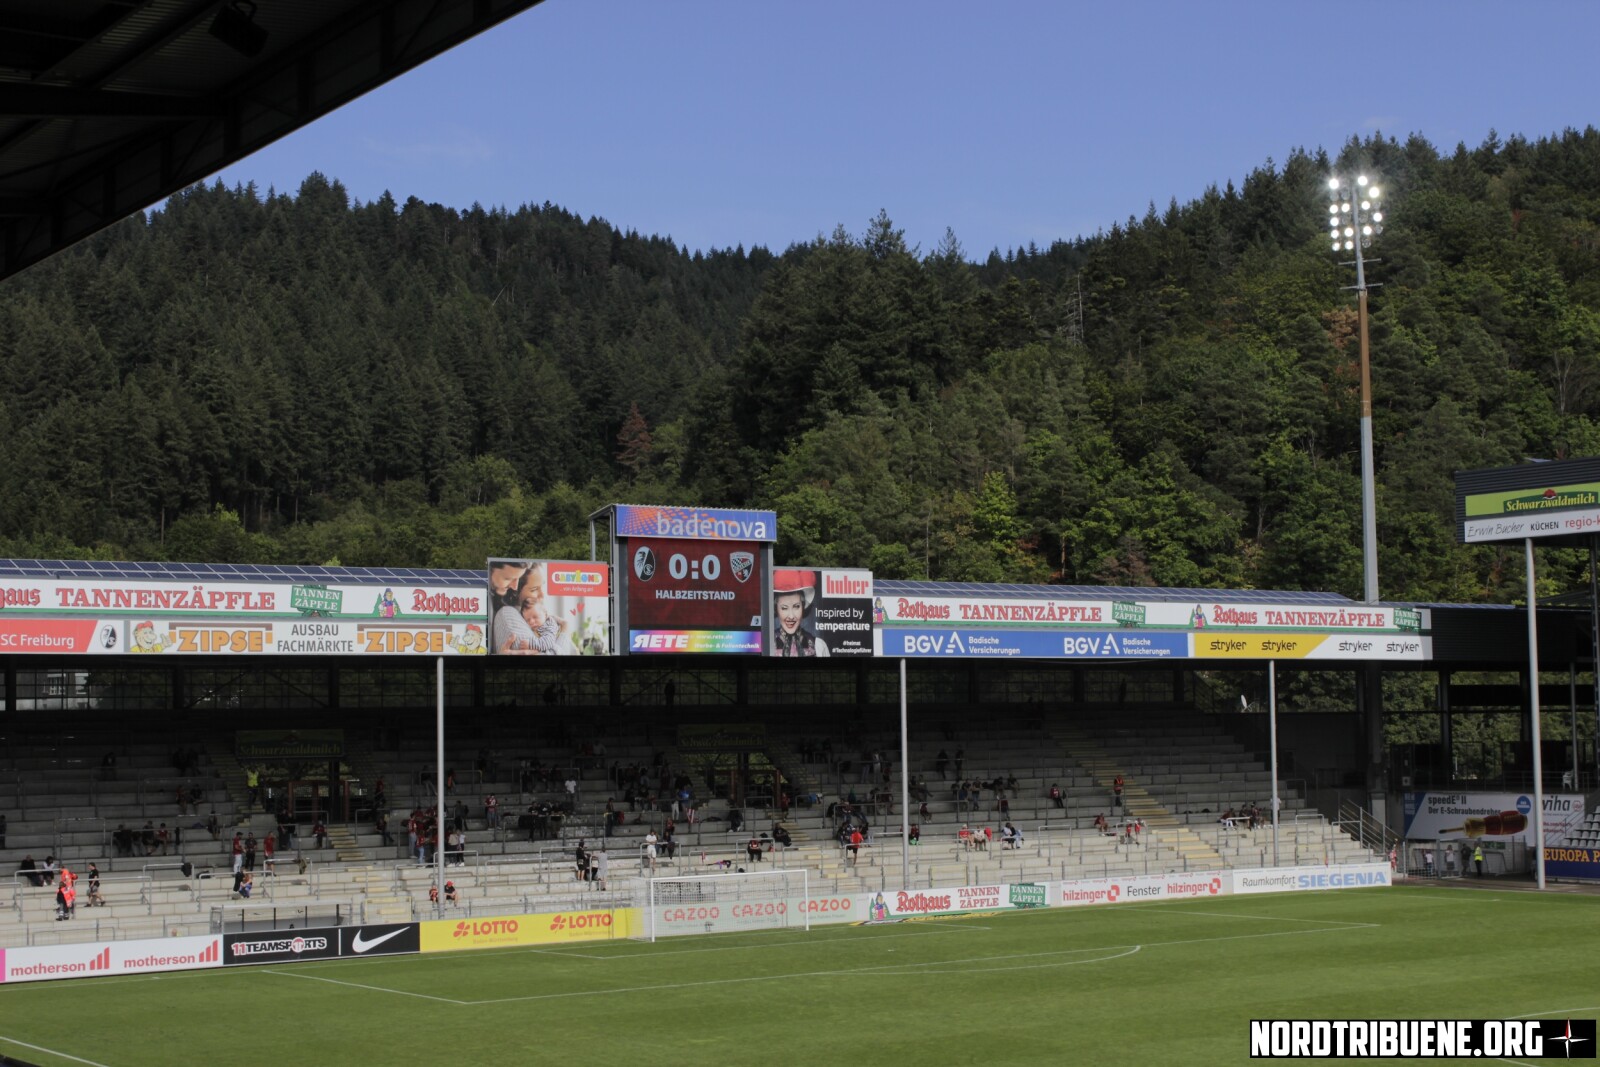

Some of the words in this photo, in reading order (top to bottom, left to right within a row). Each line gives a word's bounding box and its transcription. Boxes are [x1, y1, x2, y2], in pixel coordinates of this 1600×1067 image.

[1506, 493, 1595, 511] Schwarzwaldmilch
[657, 511, 766, 538] badenova
[1467, 525, 1493, 537] Erwin
[1530, 520, 1559, 532] KÜCHEN
[668, 553, 721, 581] 0:0
[554, 570, 600, 583] BABYZONE
[826, 574, 869, 595] huber
[56, 585, 275, 610] TANNENZÄPFLE
[293, 586, 341, 601] TANNEN
[655, 589, 736, 601] HALBZEITSTAND
[294, 597, 338, 612] ZÄPFLE
[411, 588, 480, 616] Rothaus
[1113, 603, 1144, 616] TANNEN
[815, 608, 851, 620] Inspired
[852, 608, 864, 620] by
[896, 598, 951, 622] Rothaus
[959, 602, 1102, 622] TANNENZÄPFLE
[1114, 611, 1143, 624] ZÄPFLE
[1212, 605, 1258, 627] Rothaus
[1265, 608, 1385, 627] TANNENZÄPFLE
[1394, 609, 1421, 621] TANNEN
[291, 624, 339, 637] AUSBAU
[815, 622, 870, 633] temperature
[1395, 617, 1420, 629] ZÄPFLE
[0, 634, 17, 647] SC
[21, 634, 75, 651] Freiburg
[177, 629, 264, 653] ZIPSE
[277, 637, 354, 652] FACHMÄRKTE
[365, 630, 444, 652] ZIPSE
[904, 634, 944, 654] BGV
[968, 636, 1000, 645] Badische
[1063, 636, 1100, 655] BGV
[1122, 637, 1151, 646] Badische
[1210, 639, 1247, 652] stryker
[1261, 639, 1297, 652] stryker
[1338, 640, 1373, 653] stryker
[1385, 641, 1419, 653] stryker
[969, 646, 1020, 656] Versicherungen
[1122, 647, 1171, 657] Versicherungen
[1428, 806, 1439, 814] Der
[1543, 849, 1590, 863] EUROPA
[1242, 874, 1296, 888] Raumkomfort
[1298, 871, 1386, 888] SIEGENIA
[957, 886, 1000, 898] TANNEN
[1010, 885, 1045, 897] TANNEN
[1011, 893, 1043, 904] ZÄPFLE
[1063, 889, 1106, 903] hilzinger
[1127, 885, 1161, 897] Fenster
[1167, 882, 1208, 896] hilzinger
[798, 897, 851, 913] CAZOO
[895, 890, 952, 914] Rothaus
[959, 897, 999, 909] ZÄPFLE
[664, 906, 720, 922] CAZOO
[732, 902, 788, 918] CAZOO
[472, 919, 519, 936] LOTTO
[568, 913, 613, 929] LOTTO
[124, 953, 196, 969] motherson
[11, 962, 86, 977] motherson
